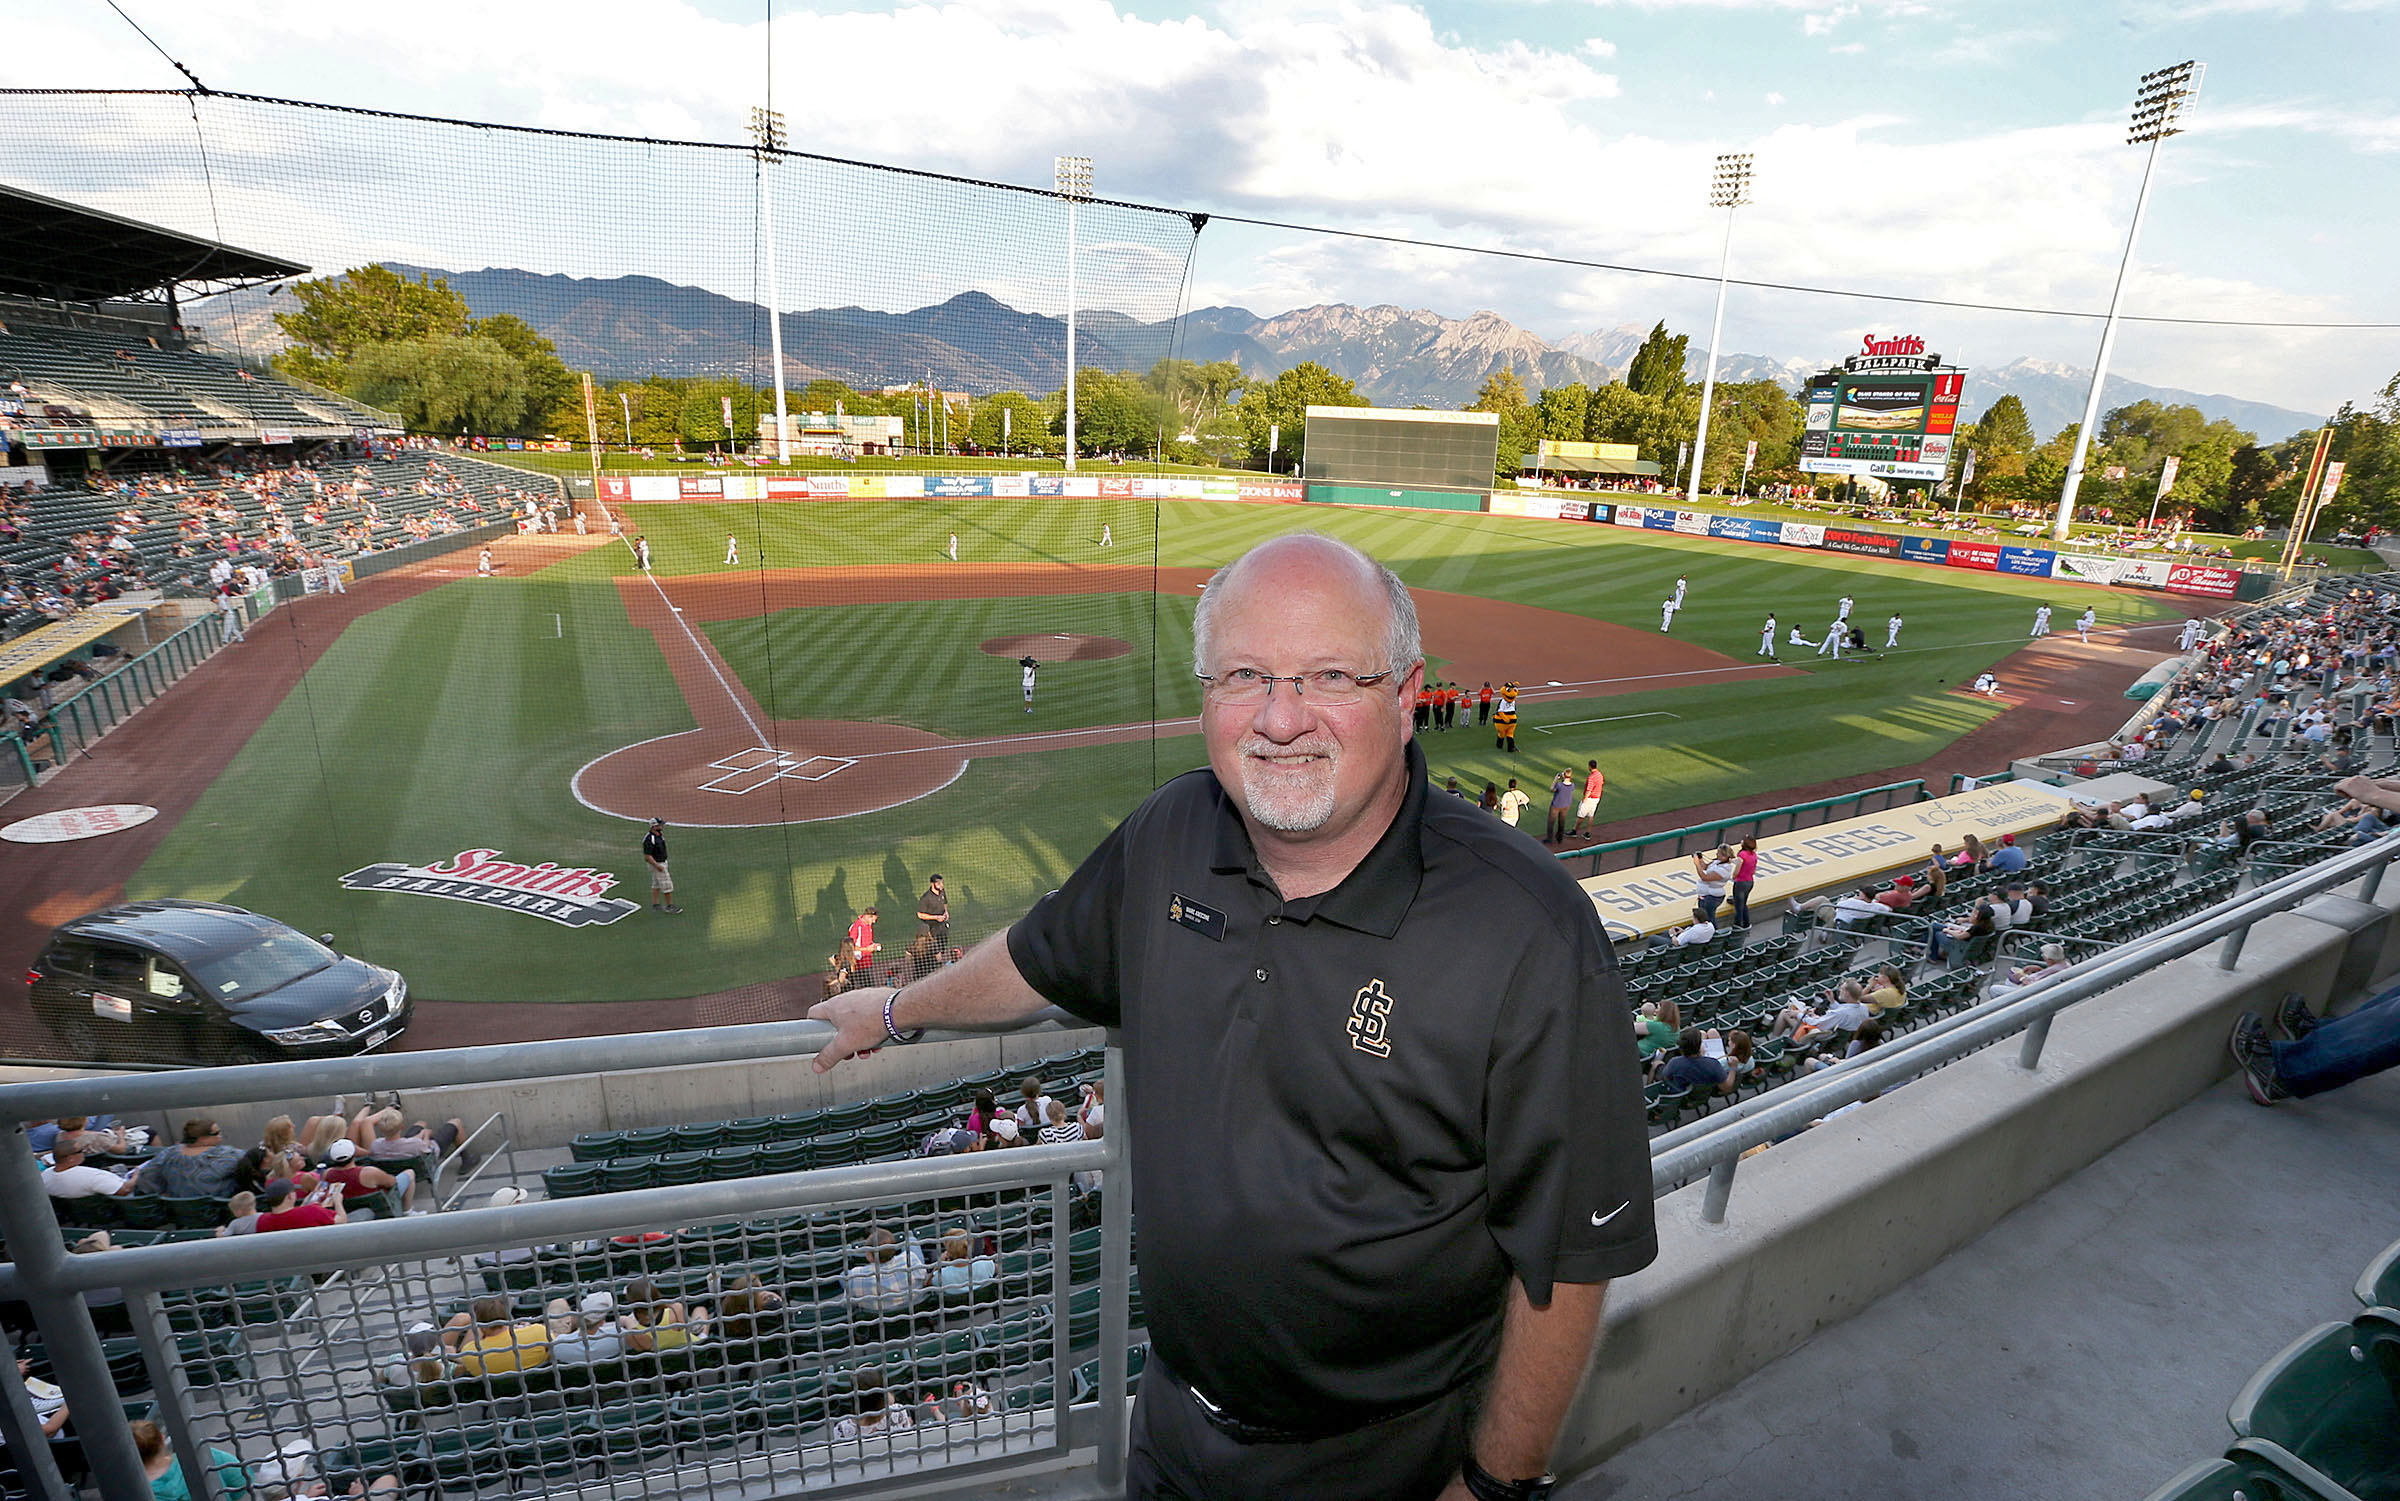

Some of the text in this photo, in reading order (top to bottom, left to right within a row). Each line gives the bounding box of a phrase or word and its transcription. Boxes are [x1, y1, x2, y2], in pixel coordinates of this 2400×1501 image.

[1861, 334, 1925, 356] Smith's
[1855, 358, 1926, 371] BALLPARK
[1870, 463, 1886, 473] Call
[1239, 486, 1303, 498] ZIONS BANK
[1851, 533, 1899, 548] Fatalities
[1952, 549, 1970, 559] WCF
[2005, 553, 2049, 564] Intermountain
[2190, 576, 2237, 588] Baseball
[1975, 803, 2062, 827] Dealerships
[427, 849, 621, 898] Smith's
[1592, 824, 1918, 913] SALT AKE BEES
[372, 875, 583, 920] BALLPARK
